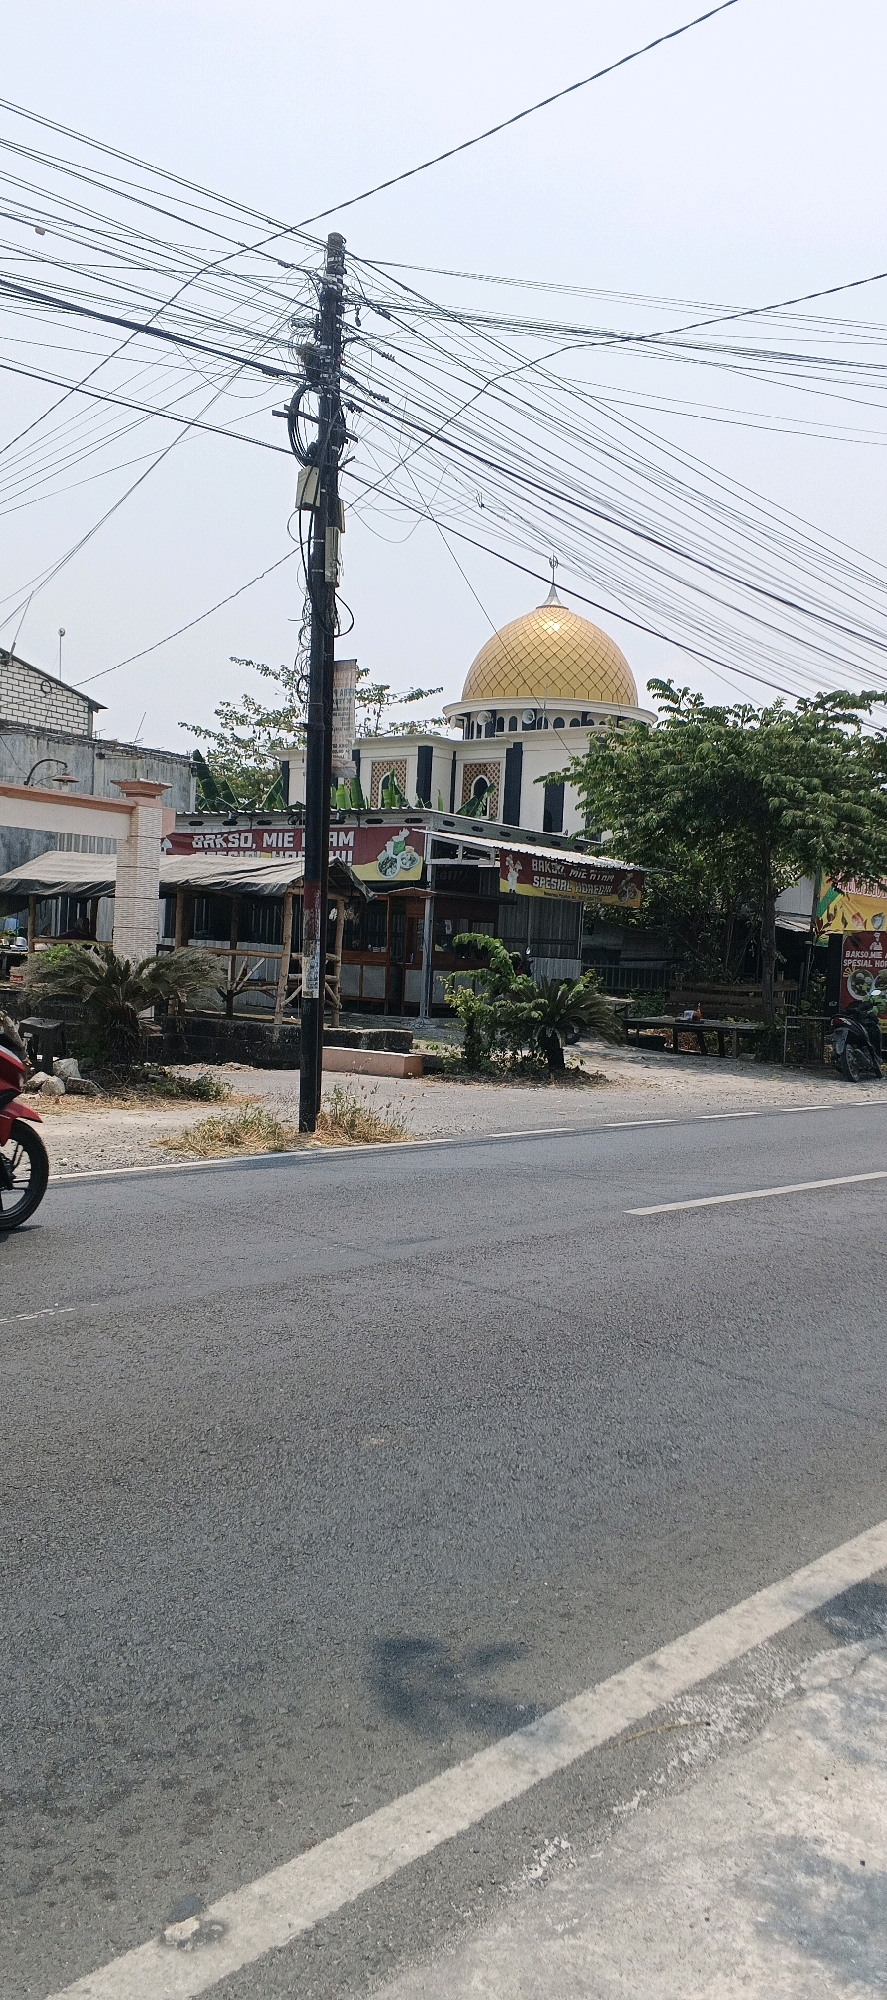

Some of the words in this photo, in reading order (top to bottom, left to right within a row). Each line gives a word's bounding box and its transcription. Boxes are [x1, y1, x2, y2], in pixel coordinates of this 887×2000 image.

[192, 833, 256, 849] BAKSO,
[263, 832, 294, 848] MIE
[302, 831, 355, 847] AM
[532, 875, 573, 892] SPESIAL
[843, 959, 873, 968] SPESIAL
